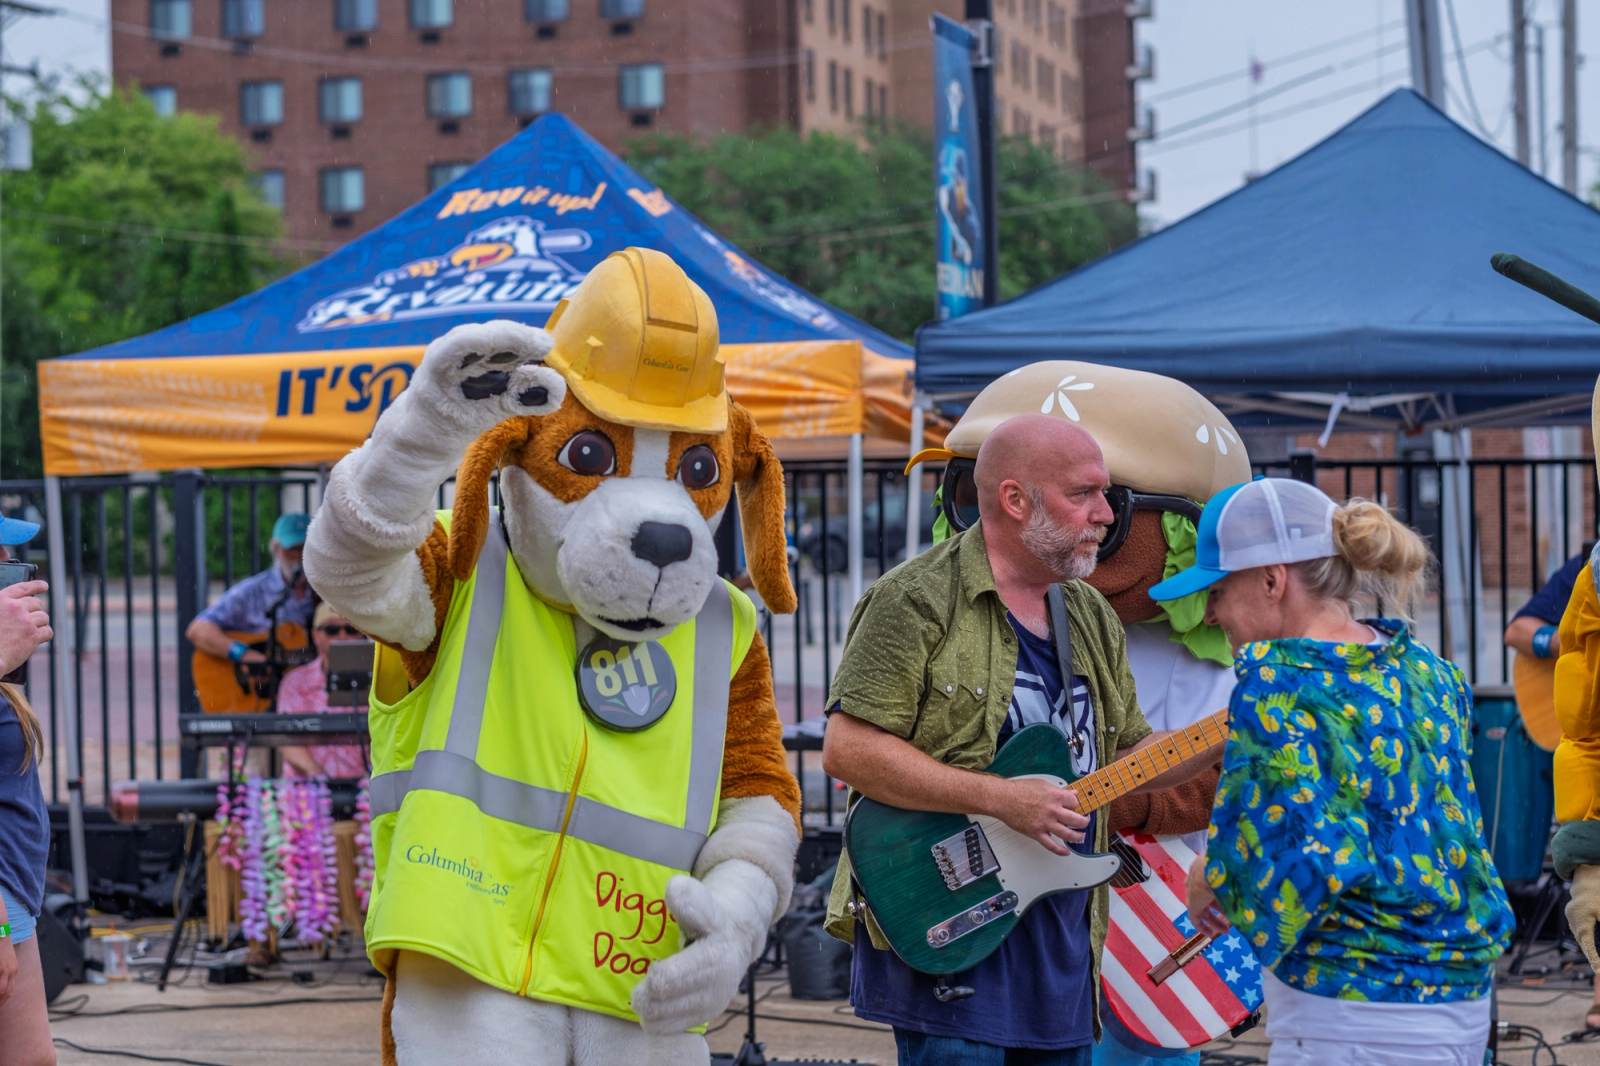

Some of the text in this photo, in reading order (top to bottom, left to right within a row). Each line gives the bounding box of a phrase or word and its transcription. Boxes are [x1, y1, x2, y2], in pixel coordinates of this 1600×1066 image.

[276, 363, 374, 417] IT'S
[590, 641, 658, 697] 811
[406, 844, 483, 883] Columbia
[596, 871, 676, 944] Digg
